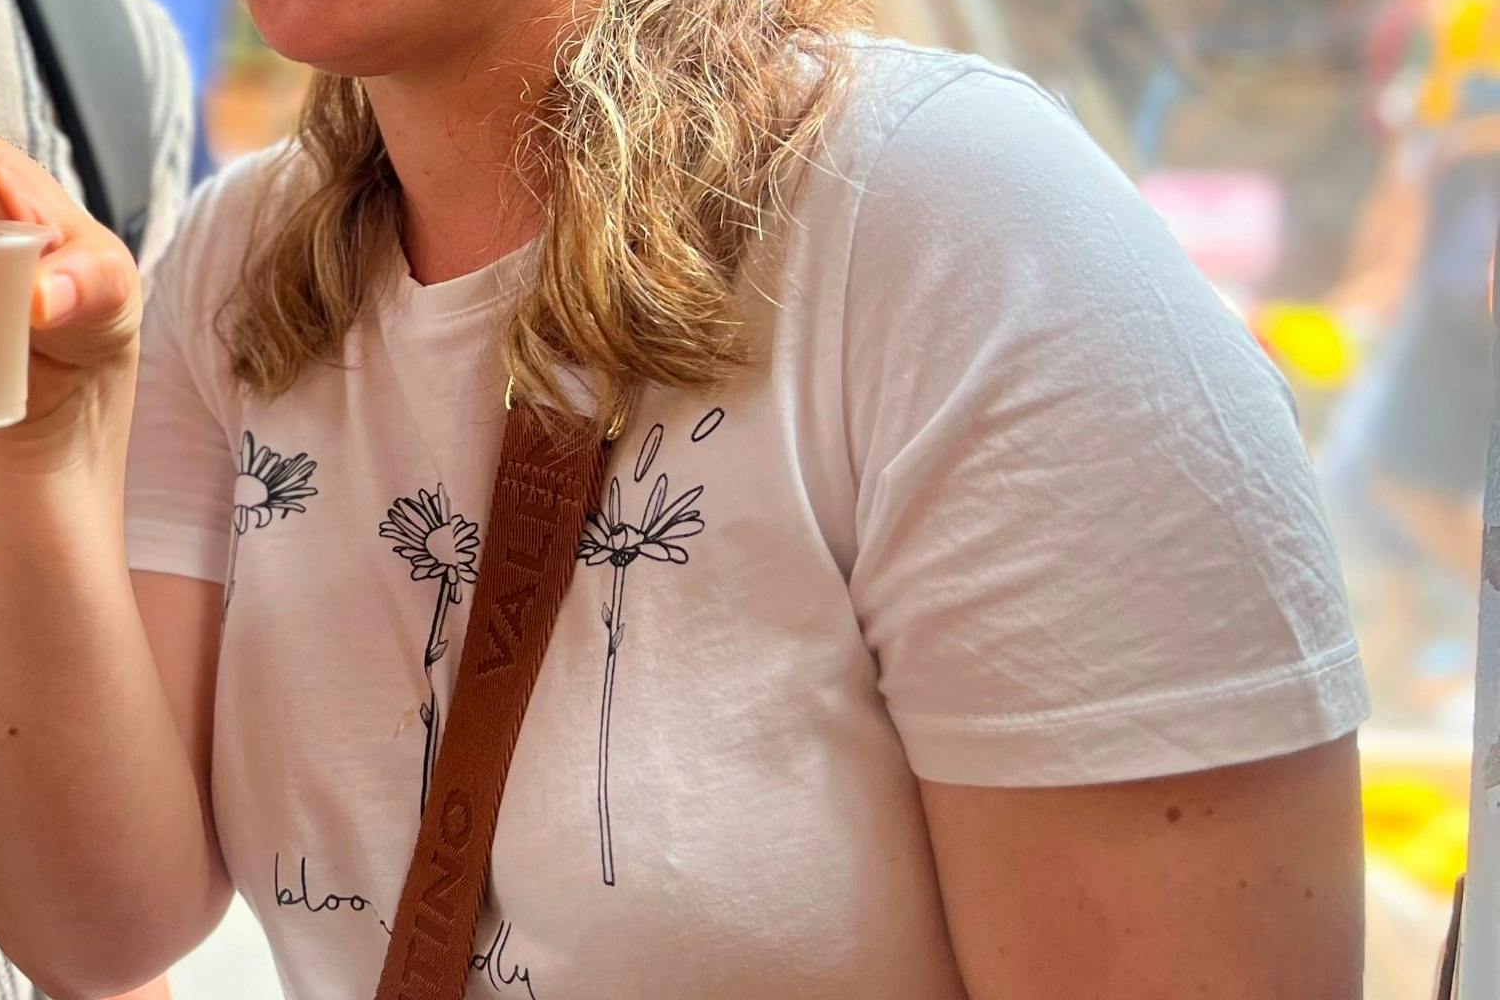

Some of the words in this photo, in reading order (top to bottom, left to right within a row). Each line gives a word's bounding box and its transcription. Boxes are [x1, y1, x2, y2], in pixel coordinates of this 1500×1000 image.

[274, 851, 380, 913] bloo
[467, 919, 536, 1000] dly
[401, 788, 475, 987] TINO
